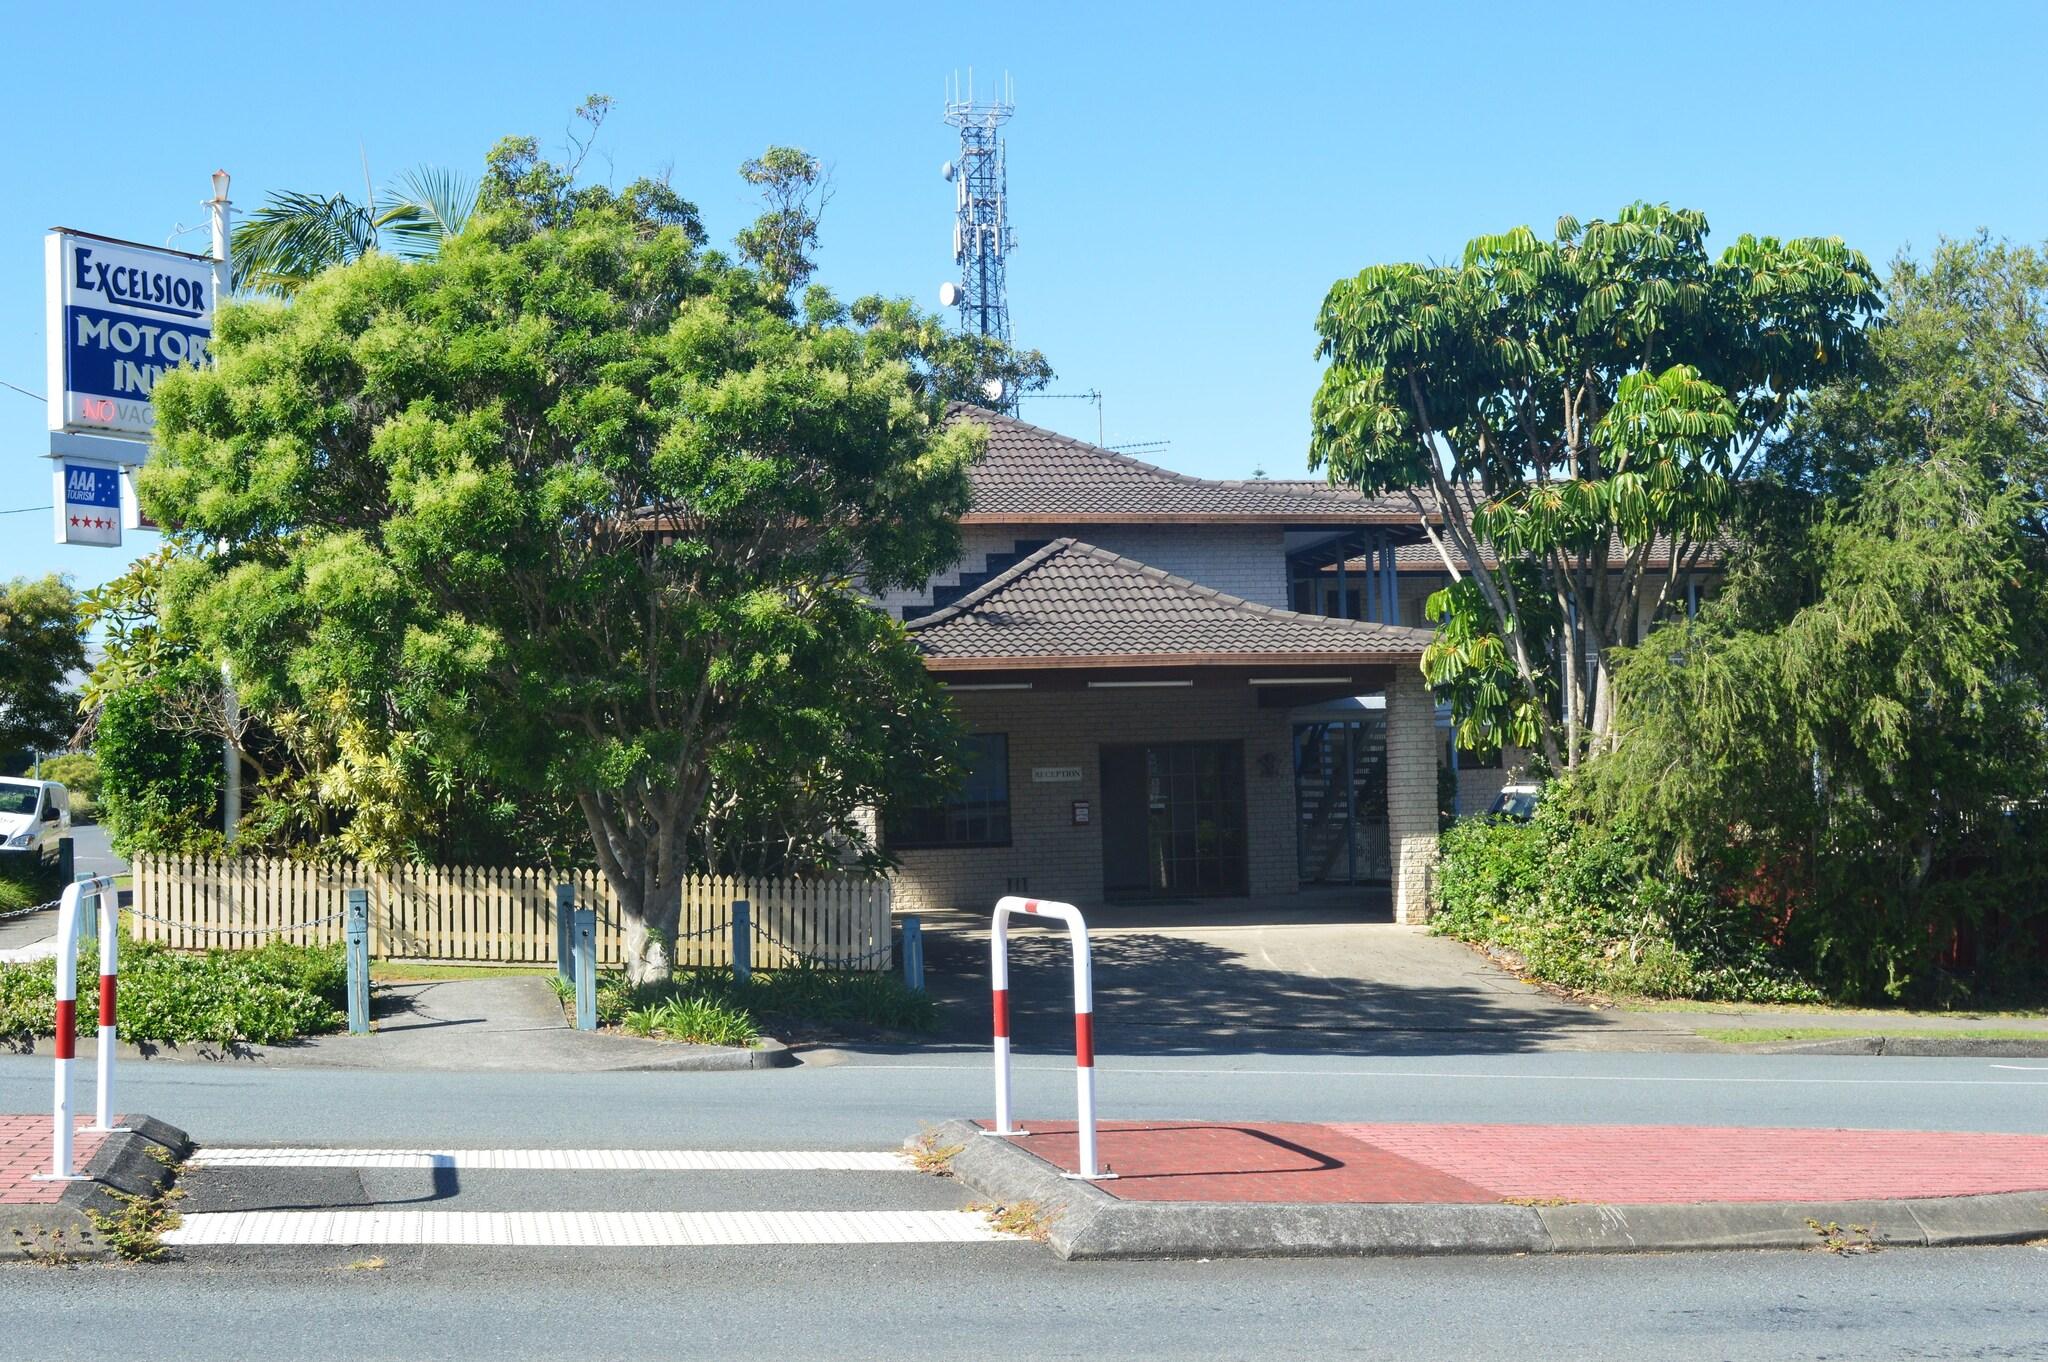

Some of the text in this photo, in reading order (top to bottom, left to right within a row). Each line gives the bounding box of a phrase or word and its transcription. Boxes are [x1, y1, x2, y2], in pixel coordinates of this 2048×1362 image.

[74, 247, 205, 316] EXCELSIOR
[76, 314, 210, 366] MOTOR
[83, 398, 116, 423] NO
[68, 470, 96, 492] AAA
[67, 489, 95, 502] TOURISM
